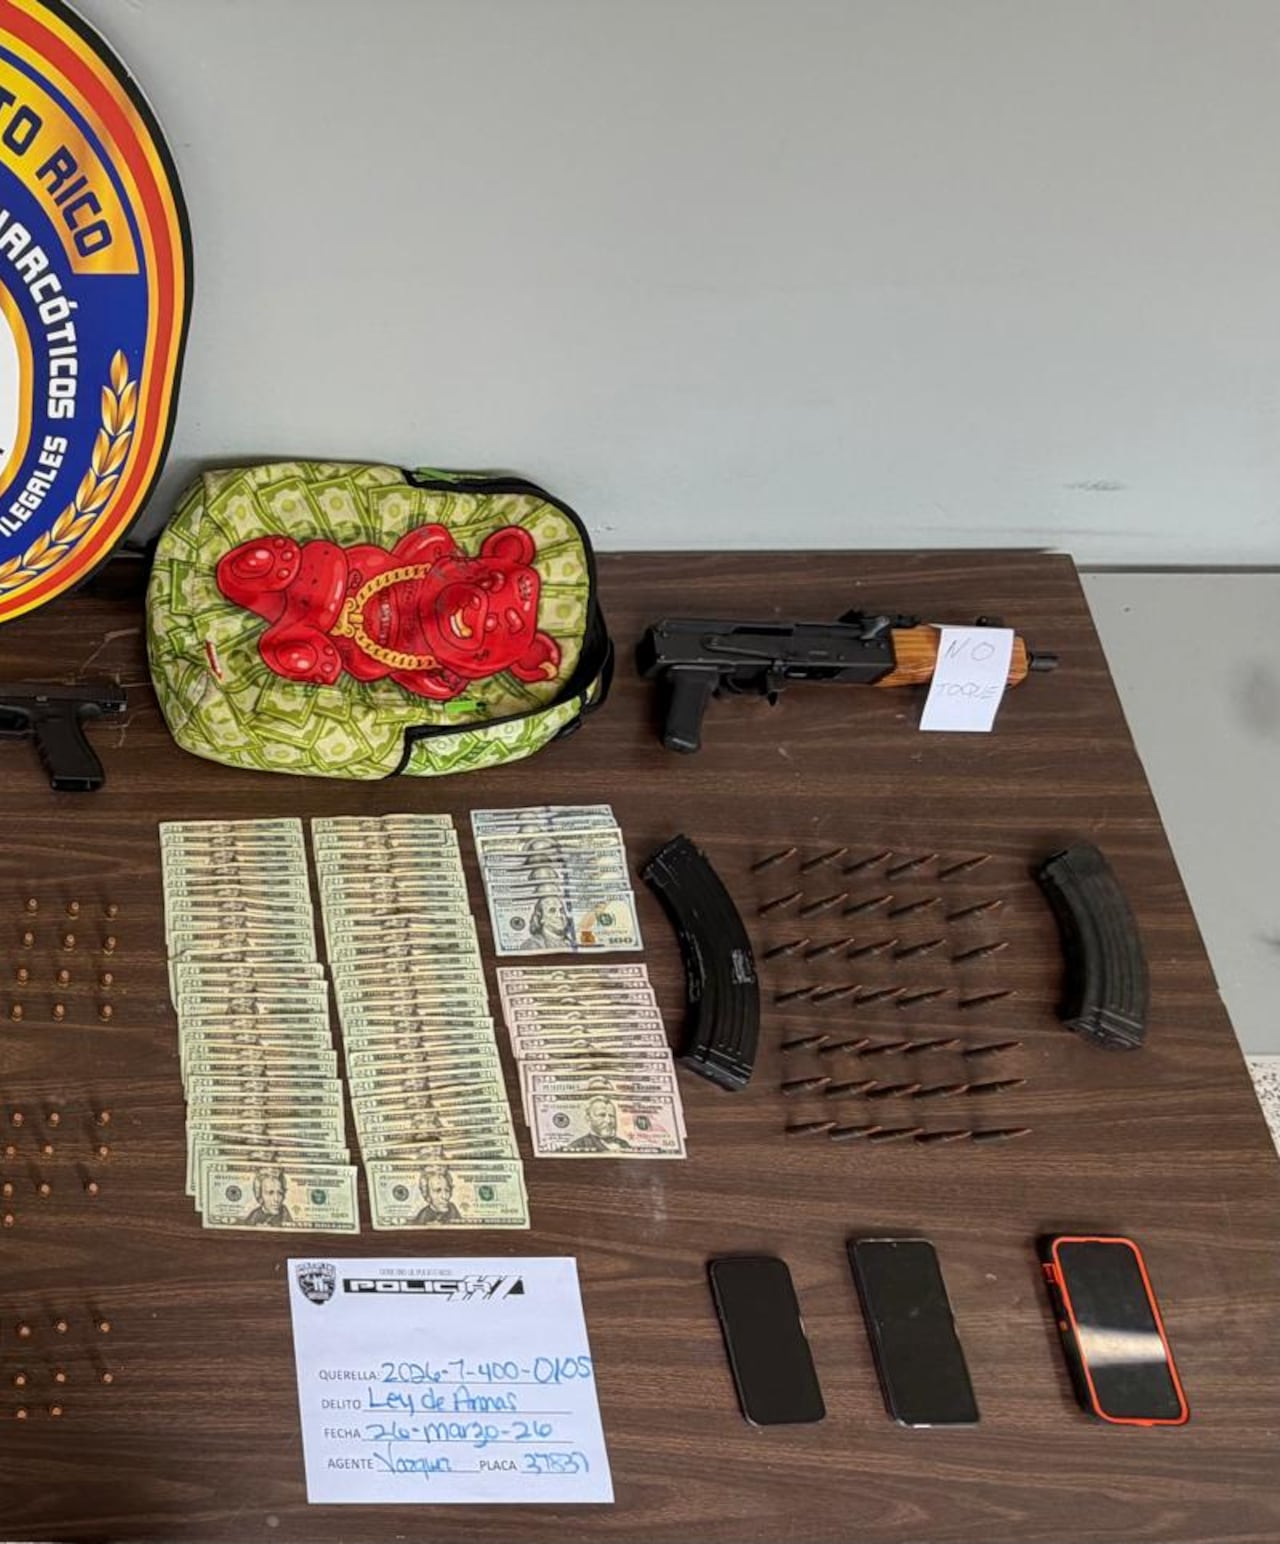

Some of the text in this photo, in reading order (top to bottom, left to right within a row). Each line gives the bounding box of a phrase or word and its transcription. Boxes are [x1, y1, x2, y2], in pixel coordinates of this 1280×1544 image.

[35, 145, 112, 258] RICO
[944, 637, 996, 662] NO
[321, 1399, 362, 1410] DELITO
[368, 1386, 416, 1417] Ley
[421, 1387, 445, 1411] de
[324, 1427, 361, 1439] FECHA
[327, 1458, 375, 1471] AGENTE
[479, 1459, 518, 1472] PLACA
